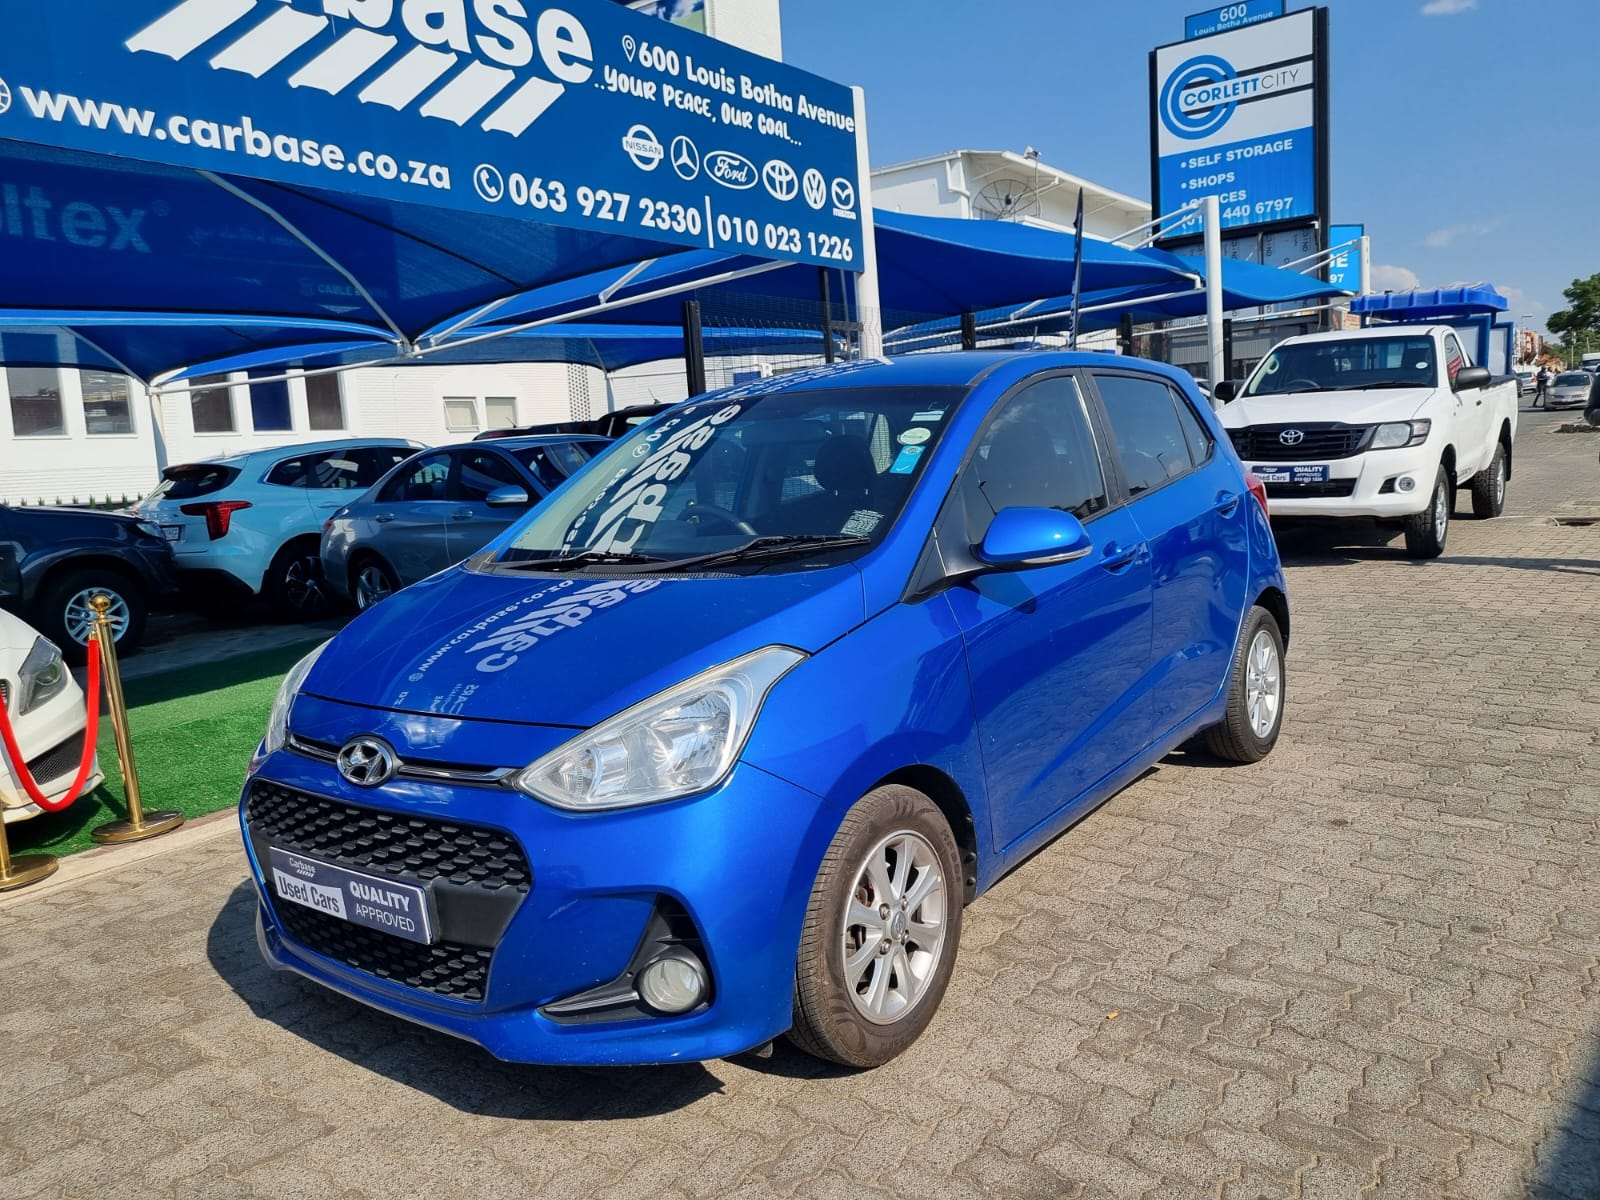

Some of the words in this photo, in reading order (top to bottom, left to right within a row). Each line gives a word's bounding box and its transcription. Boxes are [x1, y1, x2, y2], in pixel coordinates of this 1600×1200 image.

[1194, 25, 1215, 36] Louis
[1217, 20, 1240, 31] Botha
[1242, 11, 1273, 24] Avenue
[1219, 4, 1247, 22] 600
[638, 42, 680, 76] 600
[686, 56, 736, 95] Louis
[740, 74, 793, 113] Botha
[797, 94, 855, 133] Avenue
[721, 102, 752, 130] OUR
[19, 86, 450, 189] www.carbase.co.za
[624, 139, 662, 156] NISSAN
[1189, 153, 1222, 169] SELF
[1226, 139, 1293, 162] STORAGE
[714, 155, 748, 183] Ford
[1189, 172, 1235, 190] SHOPS
[0, 184, 151, 253] ltex
[509, 172, 568, 213] 063
[576, 186, 630, 222] 927
[639, 198, 701, 235] 2330
[717, 214, 759, 246] 010
[764, 224, 801, 253] 023
[808, 232, 853, 262] 1226
[1223, 205, 1250, 219] 440
[1255, 197, 1293, 214] 6797
[289, 857, 316, 874] Carbase
[278, 875, 307, 903] Used
[311, 887, 340, 913] Cars
[350, 881, 410, 912] QUALITY
[356, 903, 415, 933] APPROVED
